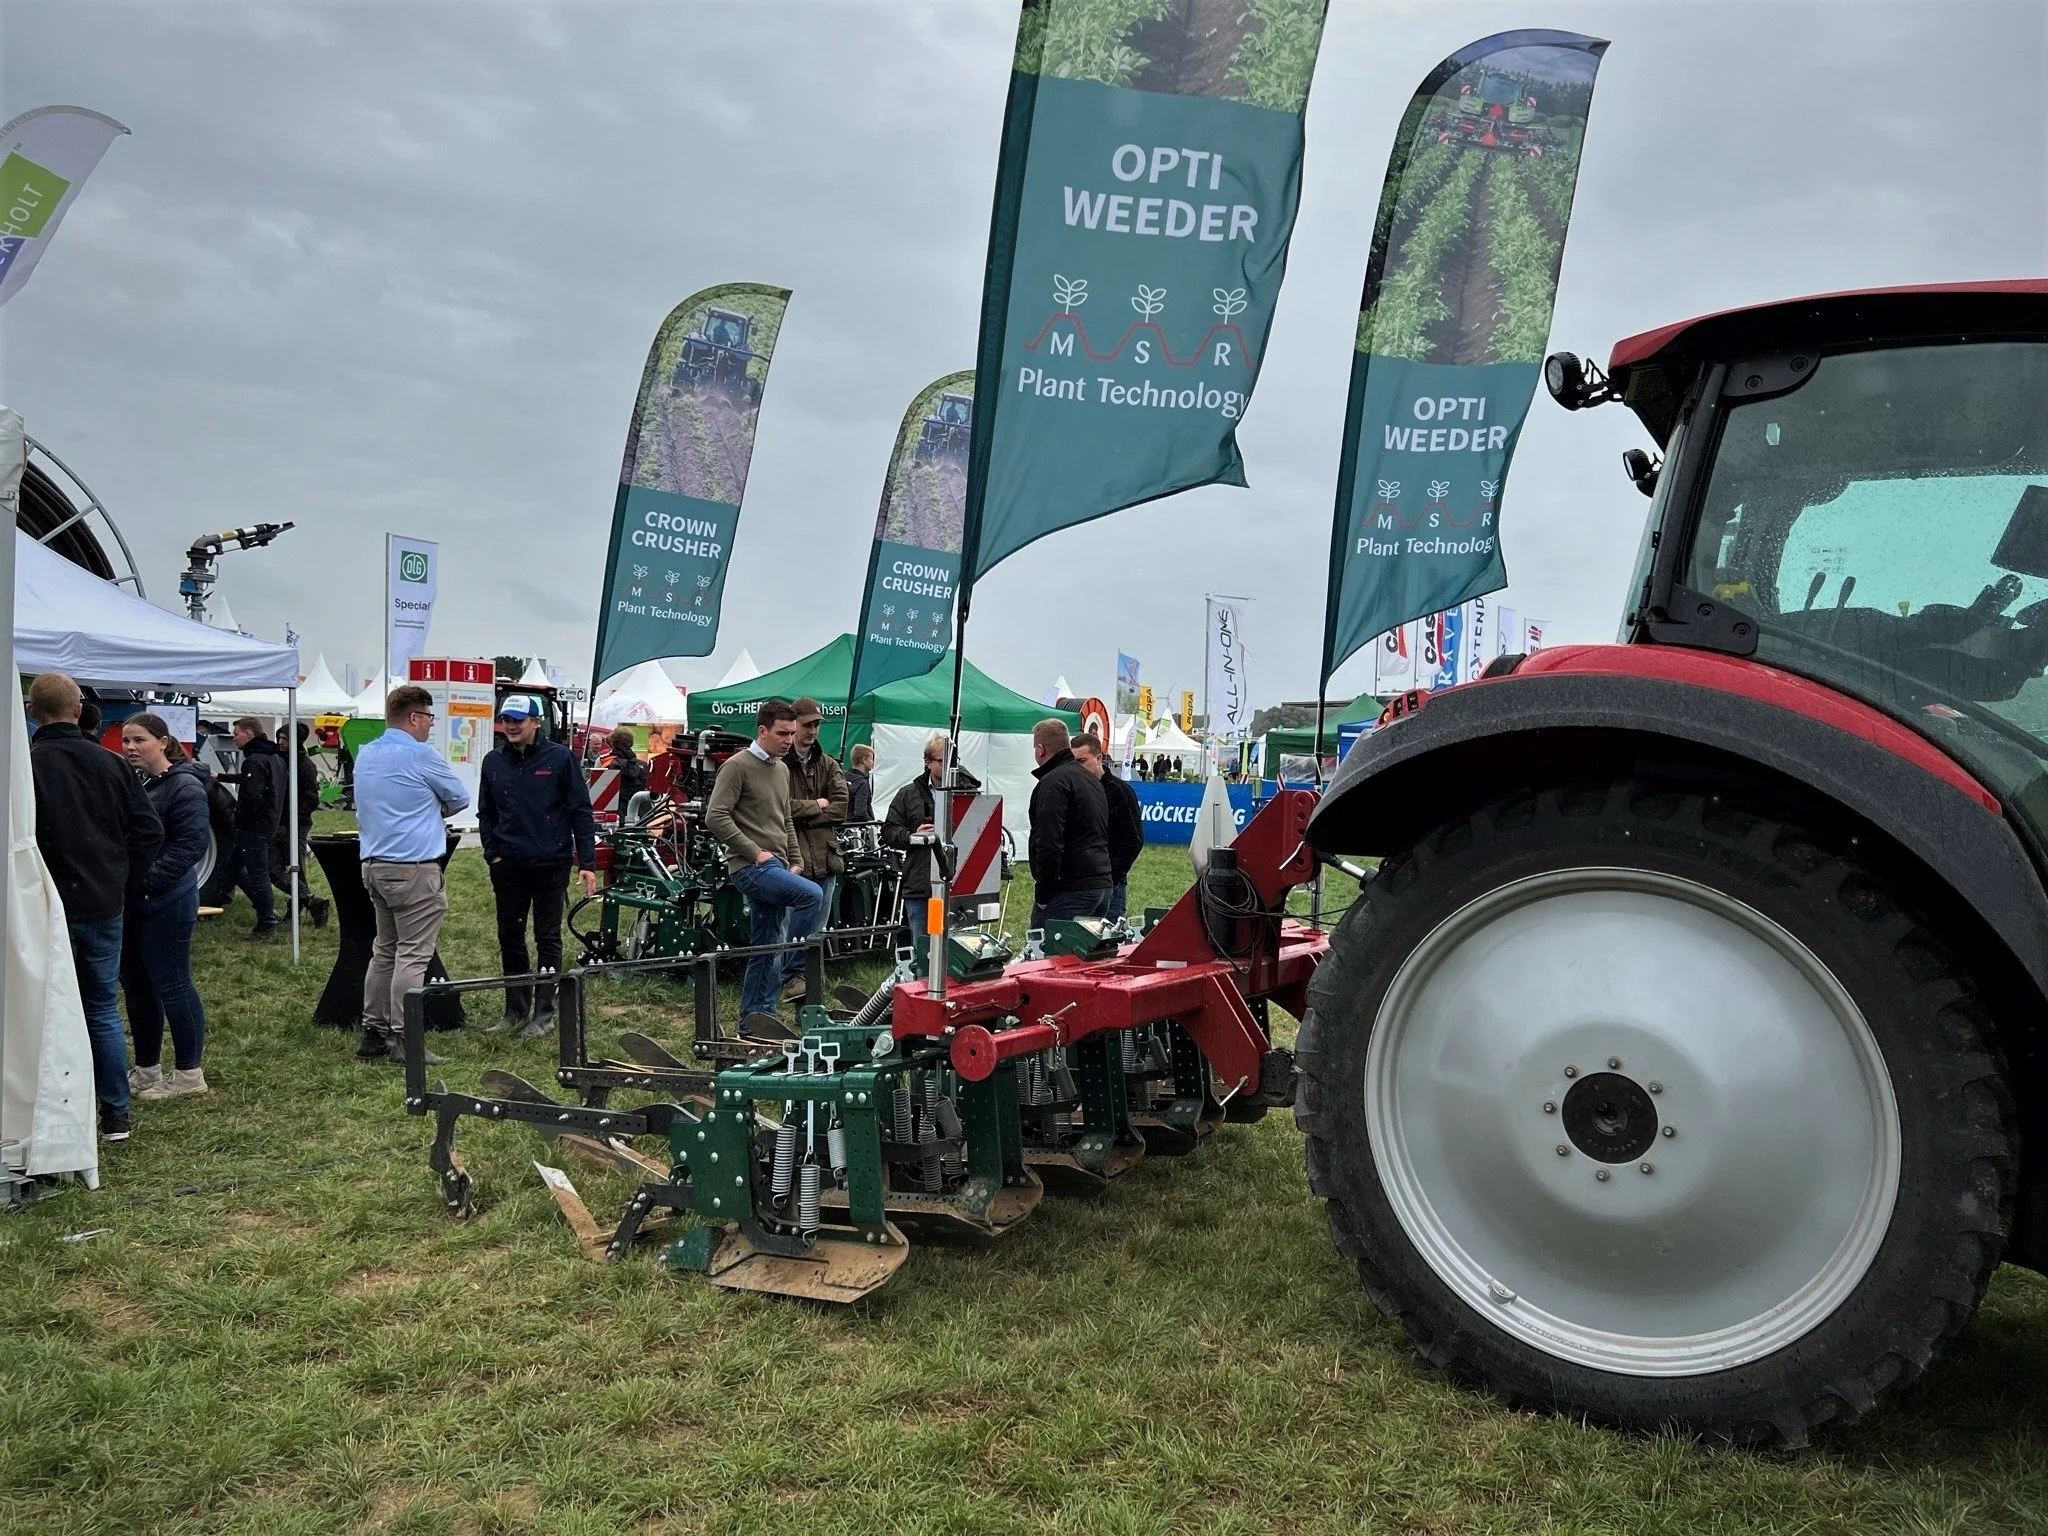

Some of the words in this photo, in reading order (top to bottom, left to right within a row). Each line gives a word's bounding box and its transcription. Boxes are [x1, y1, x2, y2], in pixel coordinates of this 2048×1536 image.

[1112, 144, 1223, 190] OPTI
[1063, 186, 1259, 242] WEEDER
[1050, 331, 1074, 357] M
[1134, 340, 1151, 364] S
[1214, 342, 1231, 366] R
[1018, 367, 1087, 401] Plant
[1097, 377, 1249, 421] Technology
[1413, 396, 1486, 421] OPTI
[1384, 424, 1508, 452] WEEDER
[644, 511, 717, 538] CROWN
[1377, 513, 1392, 530] M
[1428, 513, 1440, 528] S
[1481, 512, 1492, 527] R
[631, 529, 722, 559] CRUSHER
[1356, 537, 1400, 556] Plant
[1405, 536, 1496, 554] Technolog
[406, 555, 423, 575] DLG
[892, 560, 950, 583] CROWN
[631, 586, 642, 598] M
[665, 592, 673, 603] S
[694, 595, 703, 606] R
[882, 576, 953, 599] CRUSHER
[394, 597, 431, 612] Special
[617, 600, 647, 615] Plant
[650, 606, 713, 627] Technology
[881, 622, 890, 631] M
[906, 625, 913, 635] S
[931, 629, 938, 638] R
[1424, 614, 1437, 665] CAS
[870, 633, 893, 646] Plant
[895, 637, 946, 654] Technology
[1218, 608, 1239, 726] ALL-IN-ONE
[576, 689, 584, 701] C
